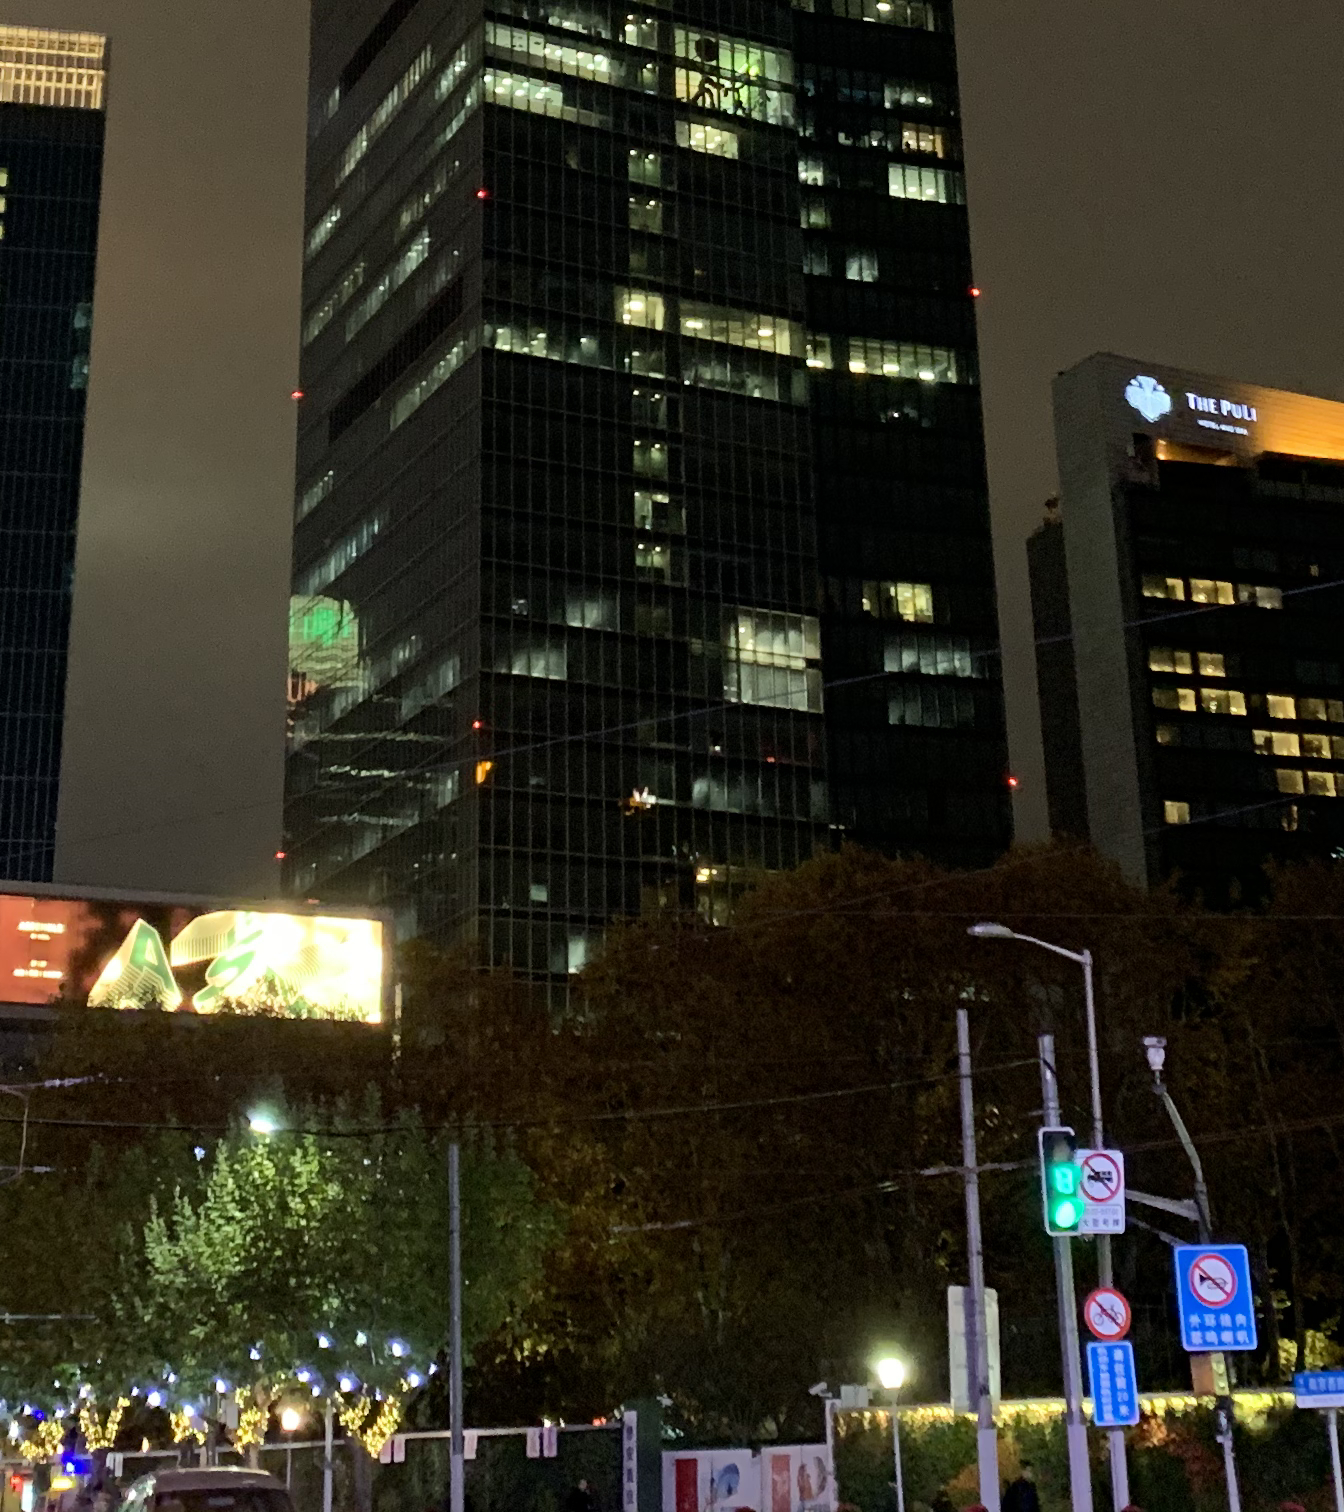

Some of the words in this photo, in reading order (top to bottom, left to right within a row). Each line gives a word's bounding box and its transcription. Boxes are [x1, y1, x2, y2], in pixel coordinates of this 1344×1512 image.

[1185, 392, 1218, 414] THE
[1189, 1312, 1247, 1328] 外环线内
